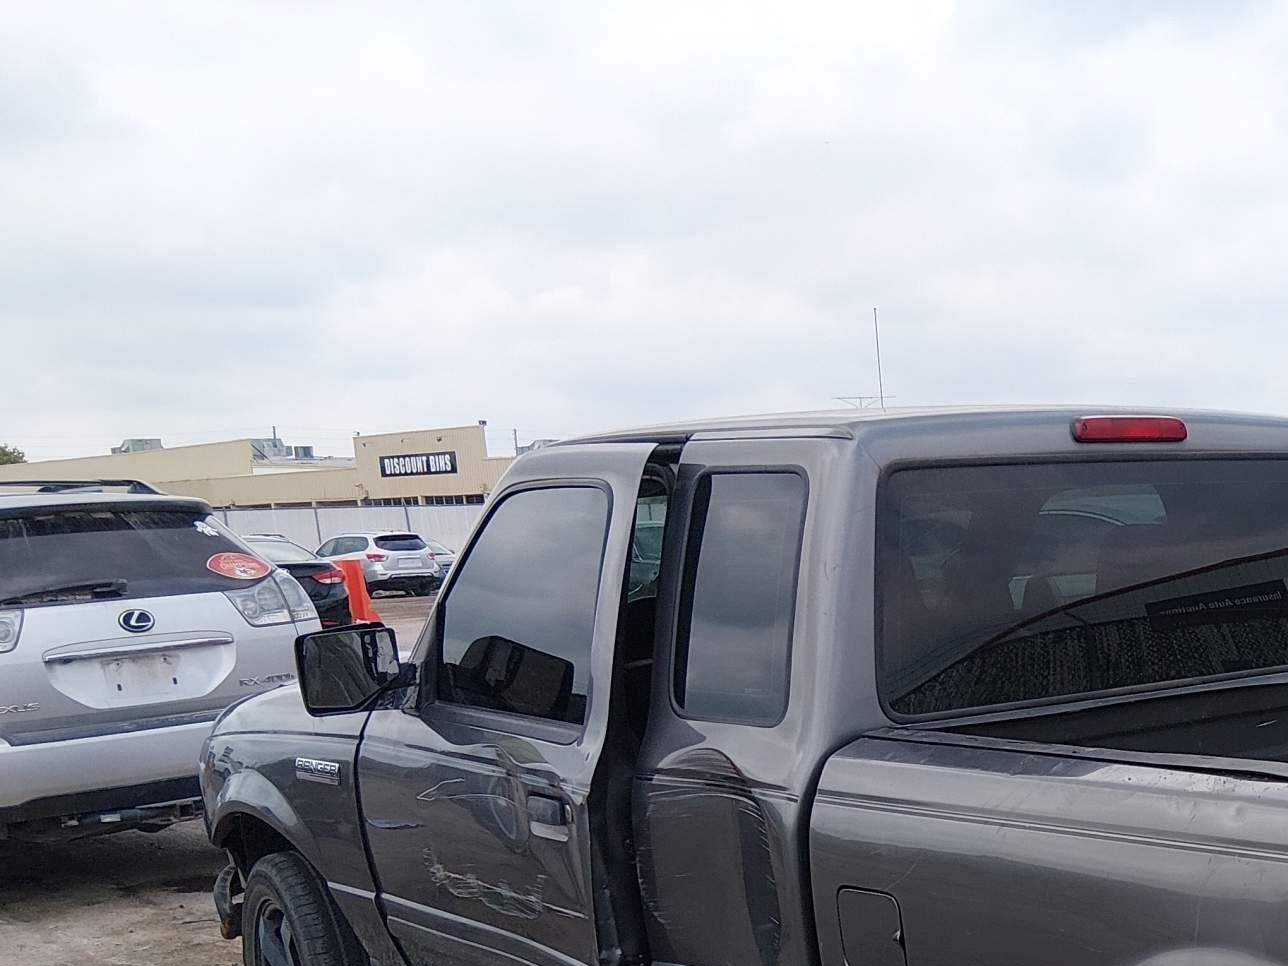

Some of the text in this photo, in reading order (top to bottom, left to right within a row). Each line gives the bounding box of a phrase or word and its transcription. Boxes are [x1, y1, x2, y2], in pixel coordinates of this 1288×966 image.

[384, 454, 452, 474] DISCOUNT BINS
[0, 703, 41, 714] XUS
[296, 759, 339, 778] RANGER
